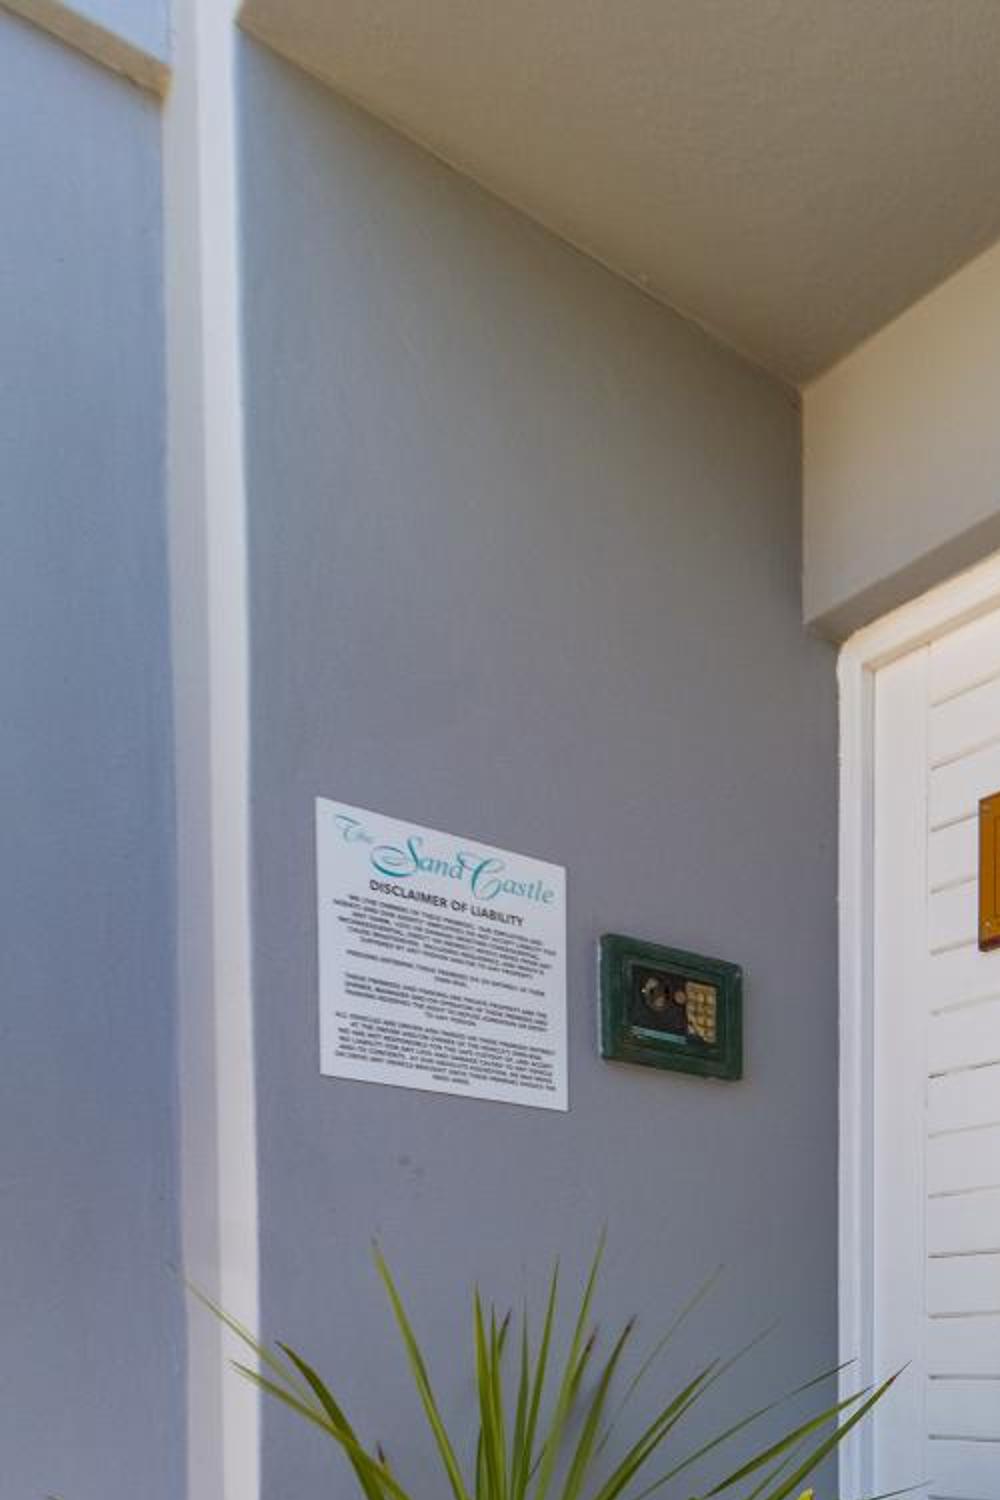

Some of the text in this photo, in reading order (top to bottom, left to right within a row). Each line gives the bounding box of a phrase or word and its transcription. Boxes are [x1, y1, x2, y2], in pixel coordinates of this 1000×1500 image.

[370, 835, 465, 879] Sand
[456, 850, 556, 903] Castle
[369, 879, 525, 927] DISCLAIMER OF LIABILITY
